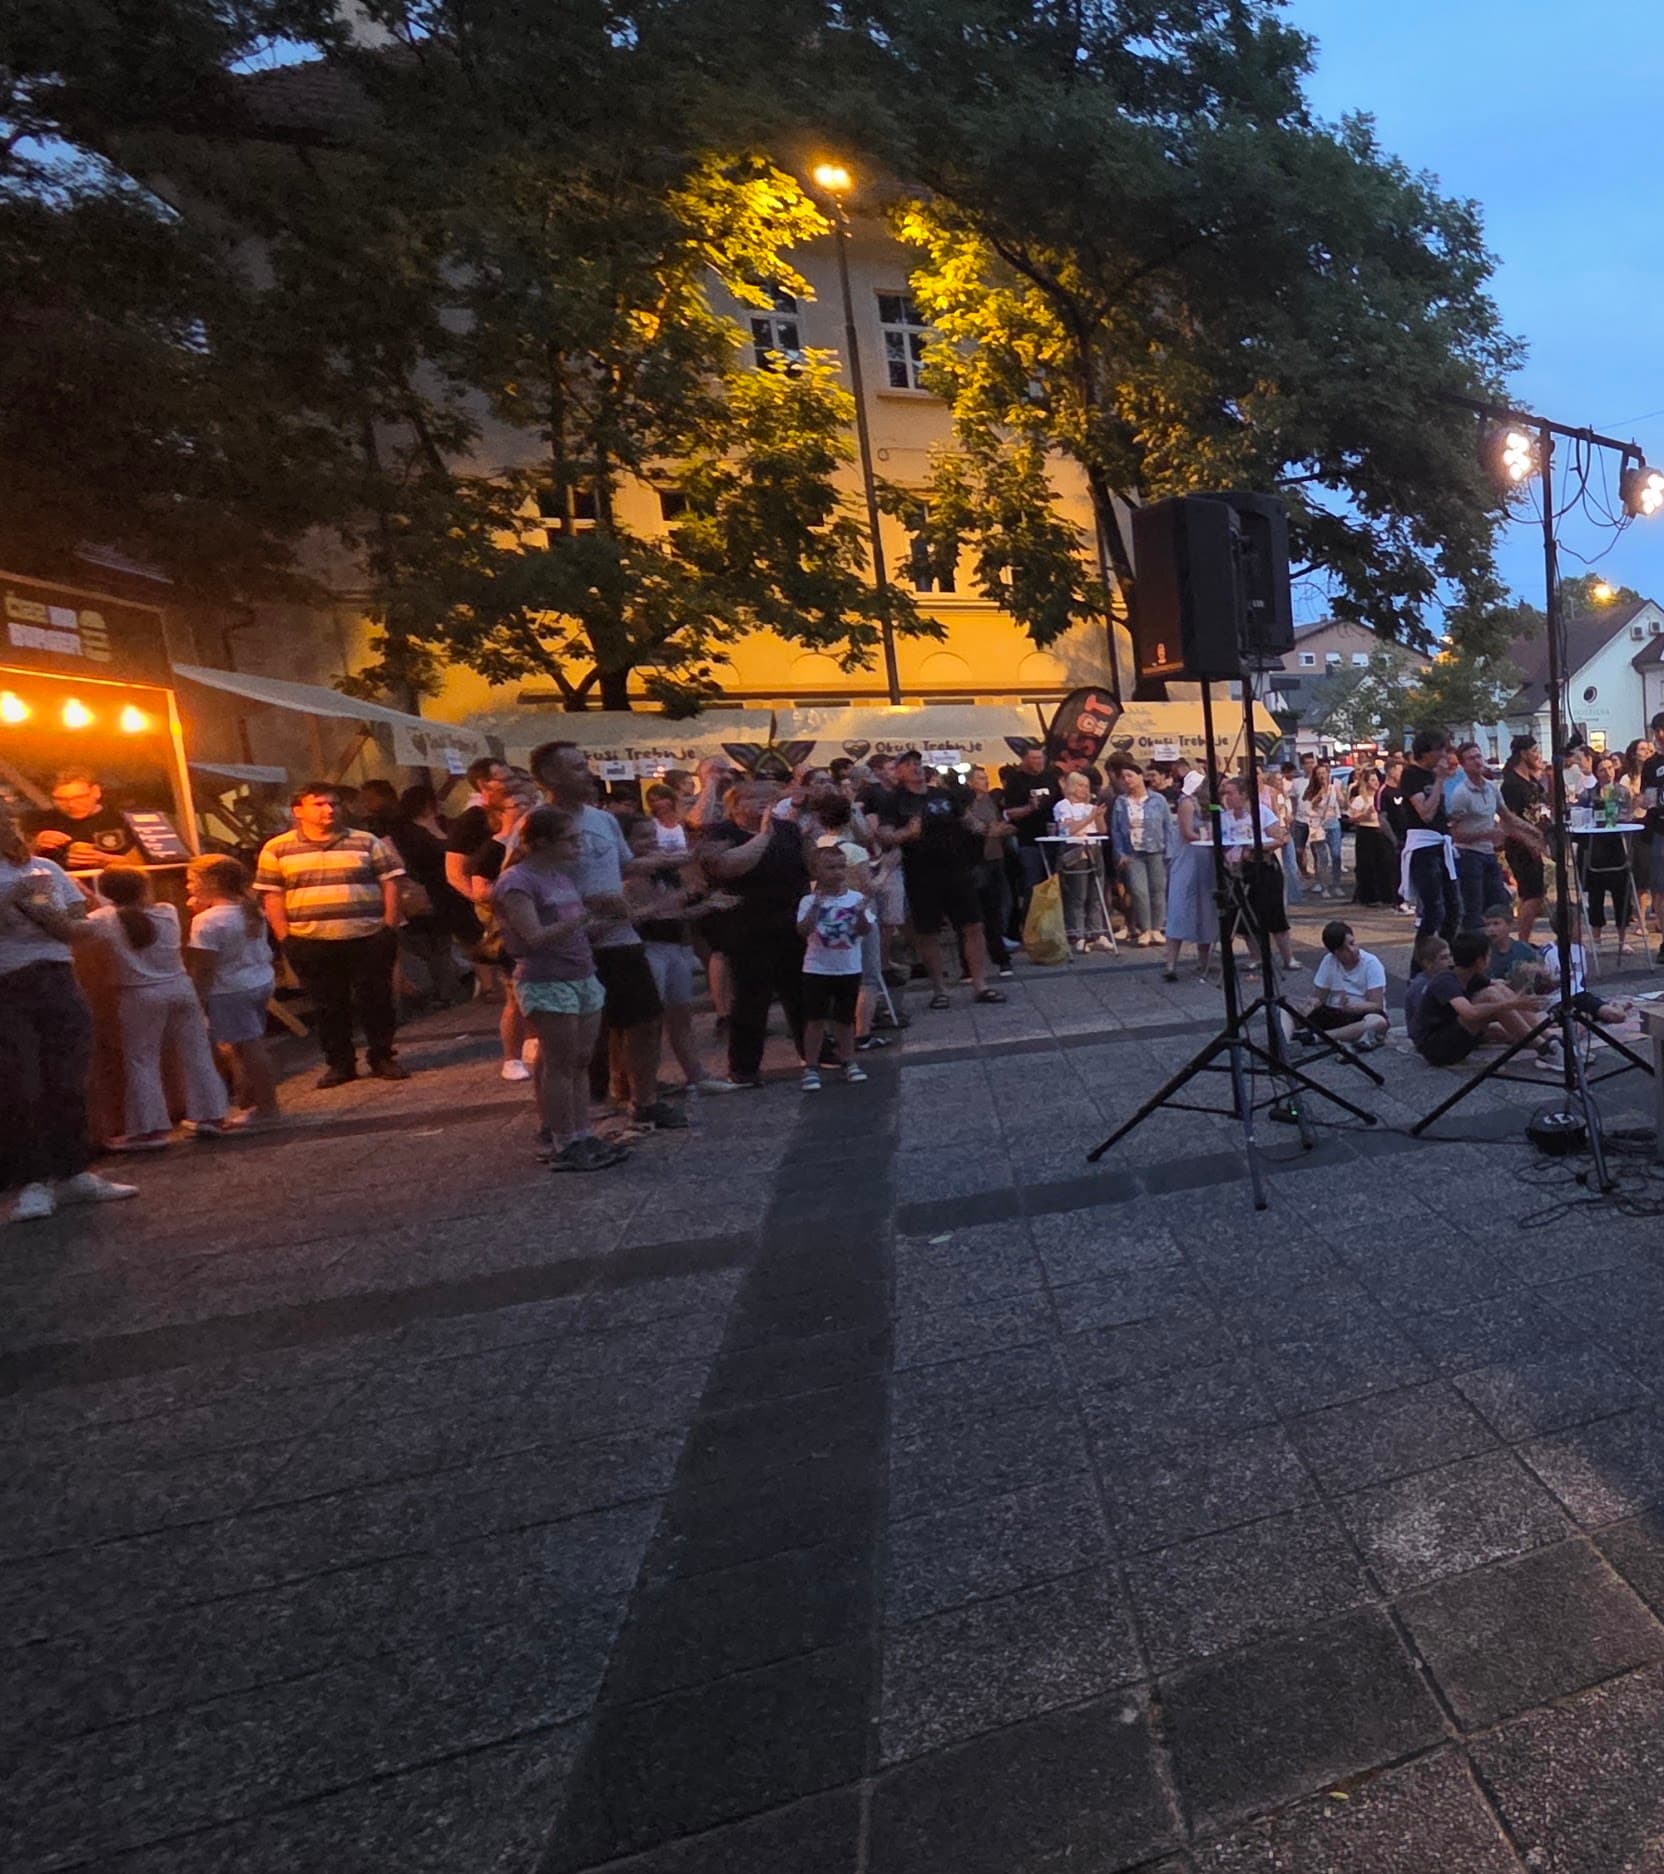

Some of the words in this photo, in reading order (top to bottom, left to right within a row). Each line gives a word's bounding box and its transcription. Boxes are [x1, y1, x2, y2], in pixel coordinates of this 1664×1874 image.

[923, 740, 982, 753] Trebnje
[1178, 735, 1228, 746] Trebje
[583, 750, 618, 761] kusi
[625, 747, 696, 761] Trebnje
